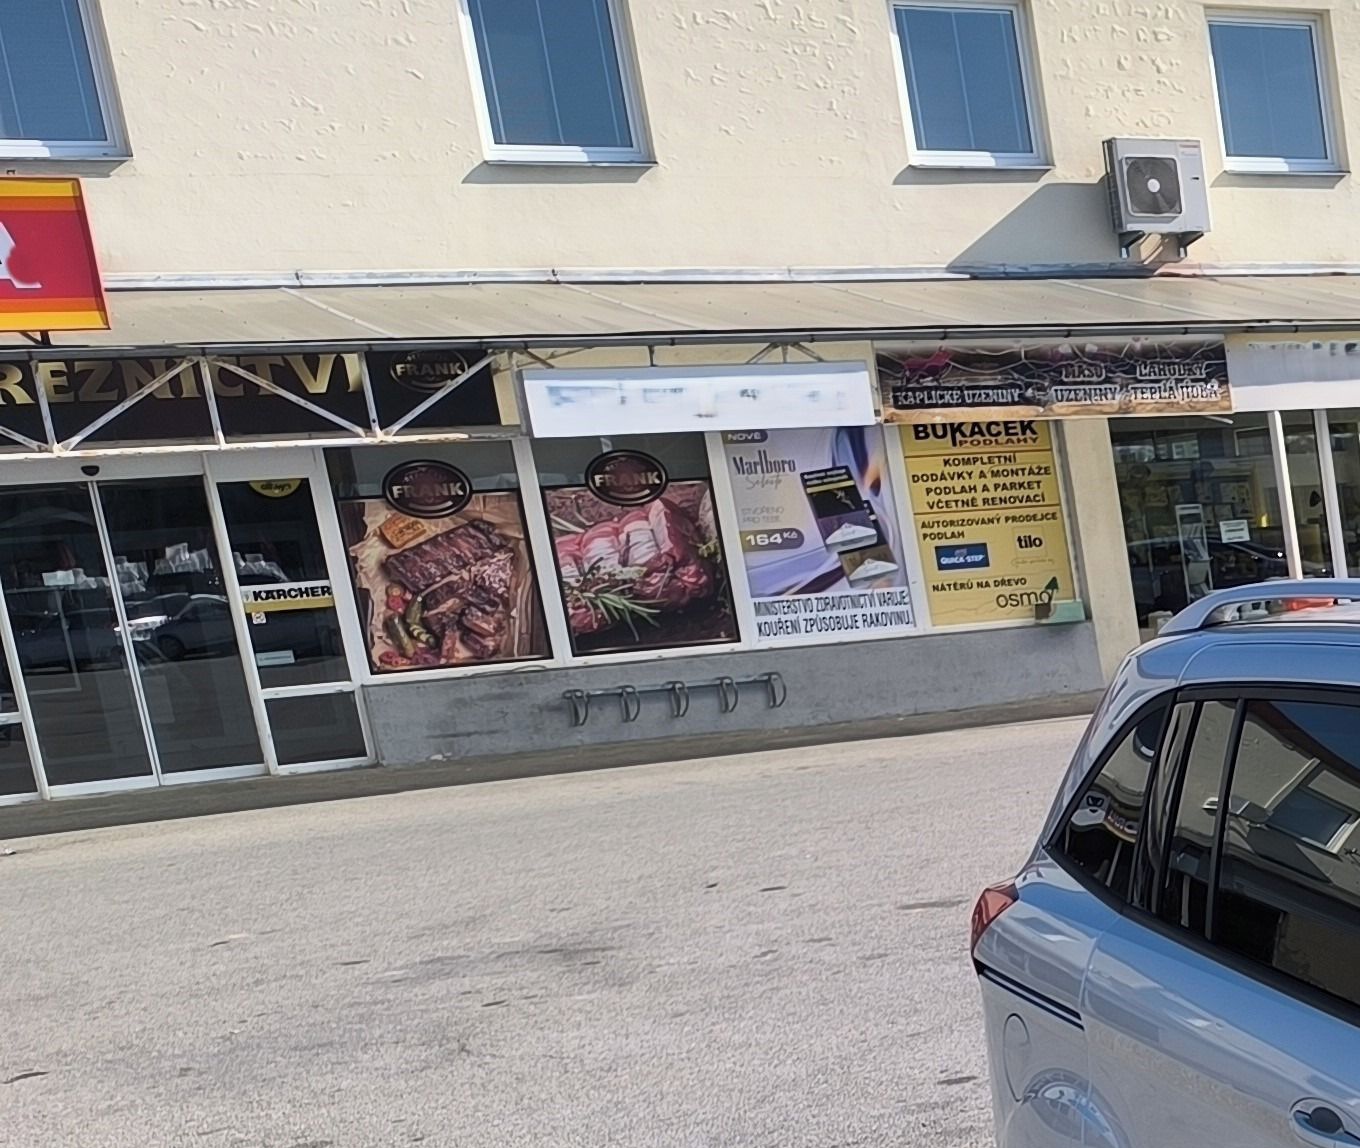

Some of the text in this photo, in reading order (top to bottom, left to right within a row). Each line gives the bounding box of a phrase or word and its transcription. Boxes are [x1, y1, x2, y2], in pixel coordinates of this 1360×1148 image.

[395, 361, 463, 377] FRANK
[958, 436, 1039, 448] PODLAHY
[732, 450, 797, 476] Marlboro
[943, 451, 1017, 467] KOMPLETNÍ
[593, 470, 661, 488] FRANK
[911, 464, 1052, 484] DODÁVKY A MONTÁŽE
[391, 482, 465, 499] FRANK
[925, 480, 1042, 497] PODLAH A PARKET
[982, 492, 1046, 507] RENOVACÍ
[920, 512, 1058, 529] AUTORIZOVANÝ PRODEJCE
[745, 531, 782, 546] 164
[922, 530, 965, 541] PODLAH
[1016, 535, 1043, 549] tilo
[976, 580, 991, 589] NA
[996, 589, 1051, 609] osmo
[757, 615, 800, 637] KOUŘENÍ
[803, 613, 860, 634] ZPŮSOBUJE
